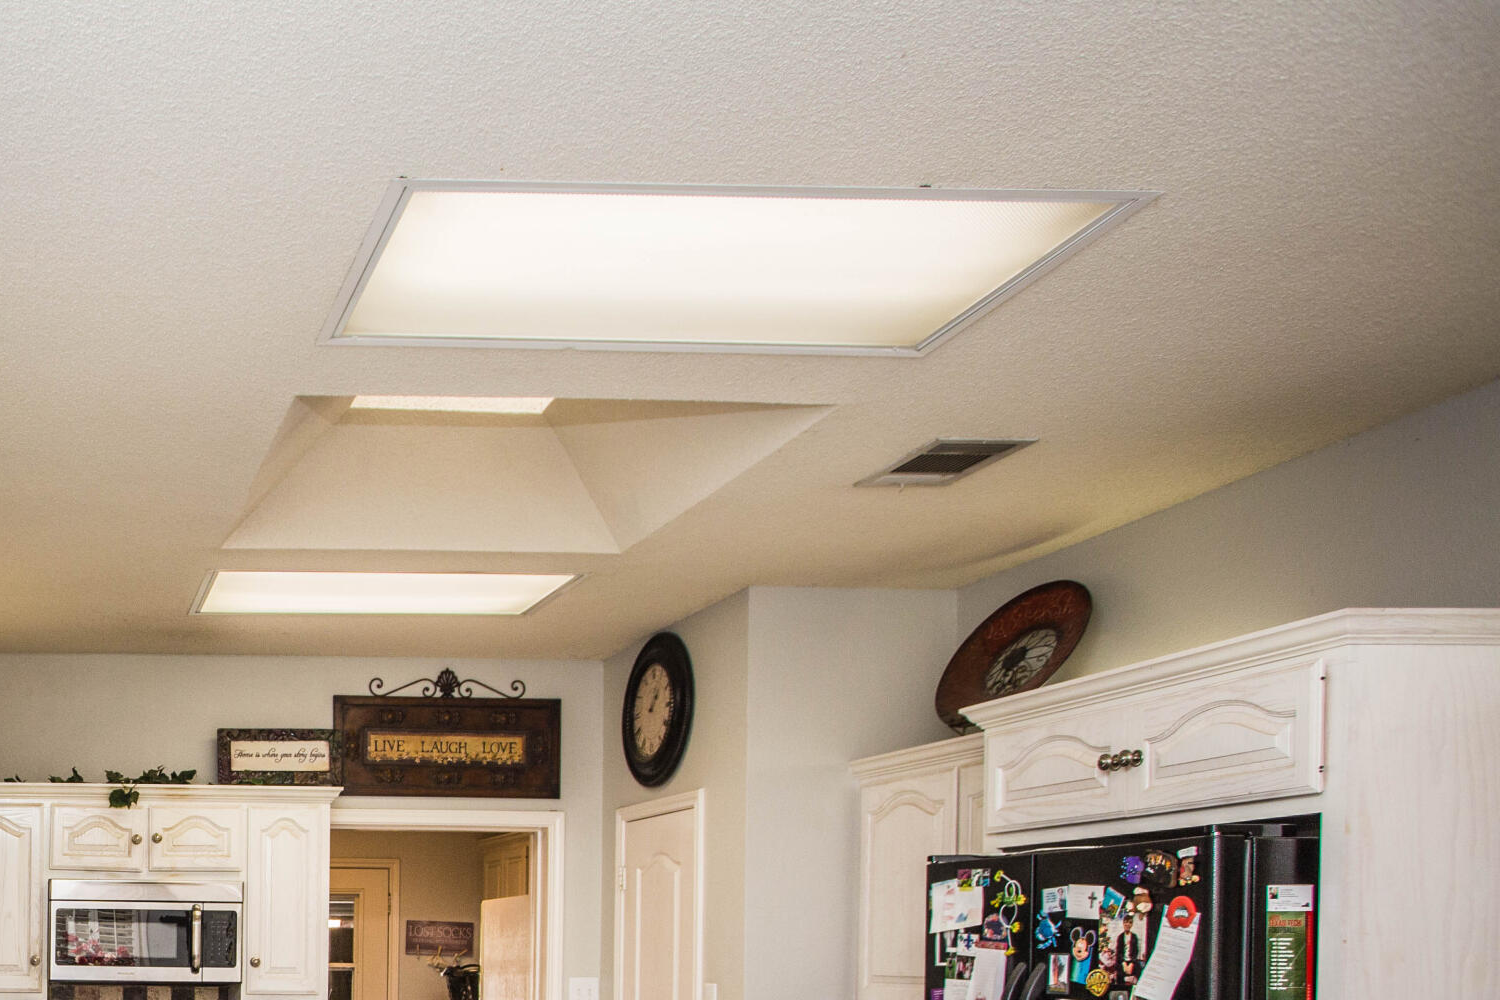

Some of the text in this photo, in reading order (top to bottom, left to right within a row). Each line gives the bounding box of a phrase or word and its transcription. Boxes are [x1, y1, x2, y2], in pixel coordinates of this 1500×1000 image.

[374, 739, 518, 755] LIVE LAUGH LOVE
[409, 925, 471, 938] LOST SOCKS
